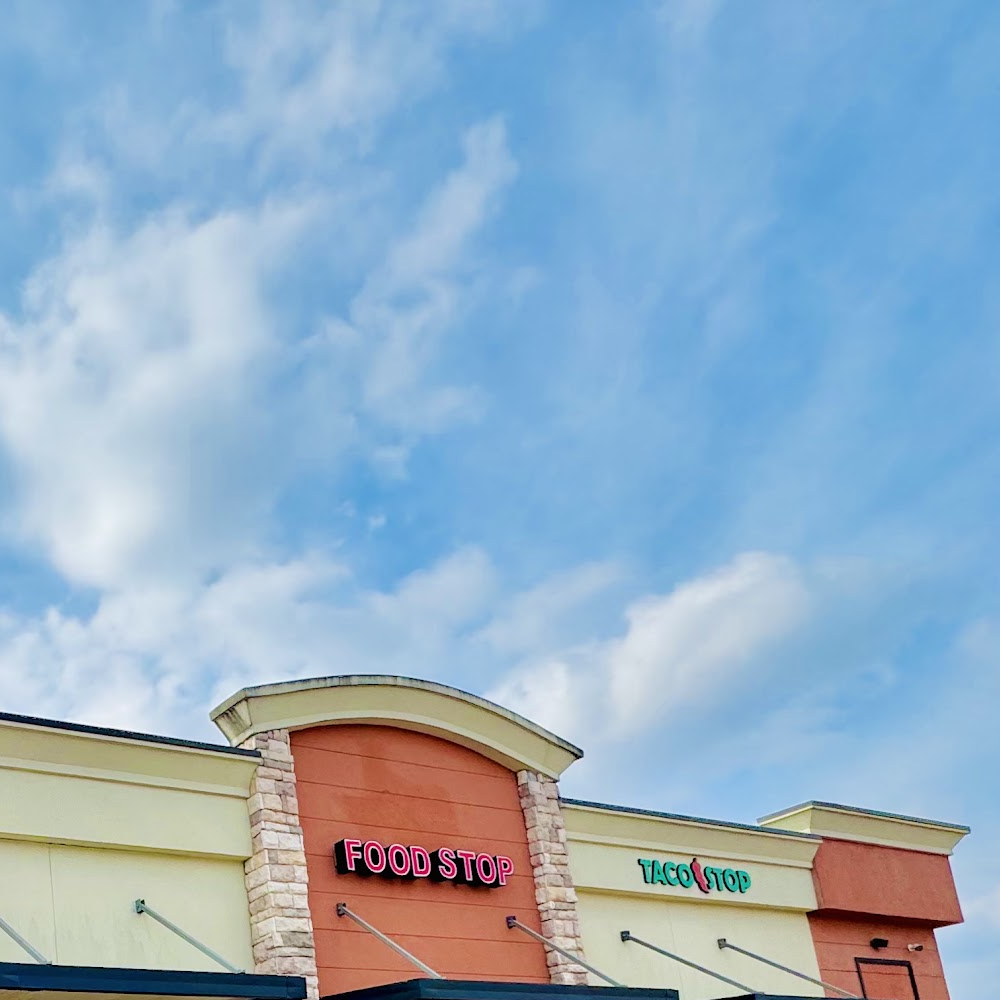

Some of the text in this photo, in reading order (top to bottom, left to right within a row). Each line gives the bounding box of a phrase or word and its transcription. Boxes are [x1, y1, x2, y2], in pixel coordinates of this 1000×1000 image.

[344, 839, 515, 886] FOOD STOP
[638, 858, 751, 893] TACO STOP
